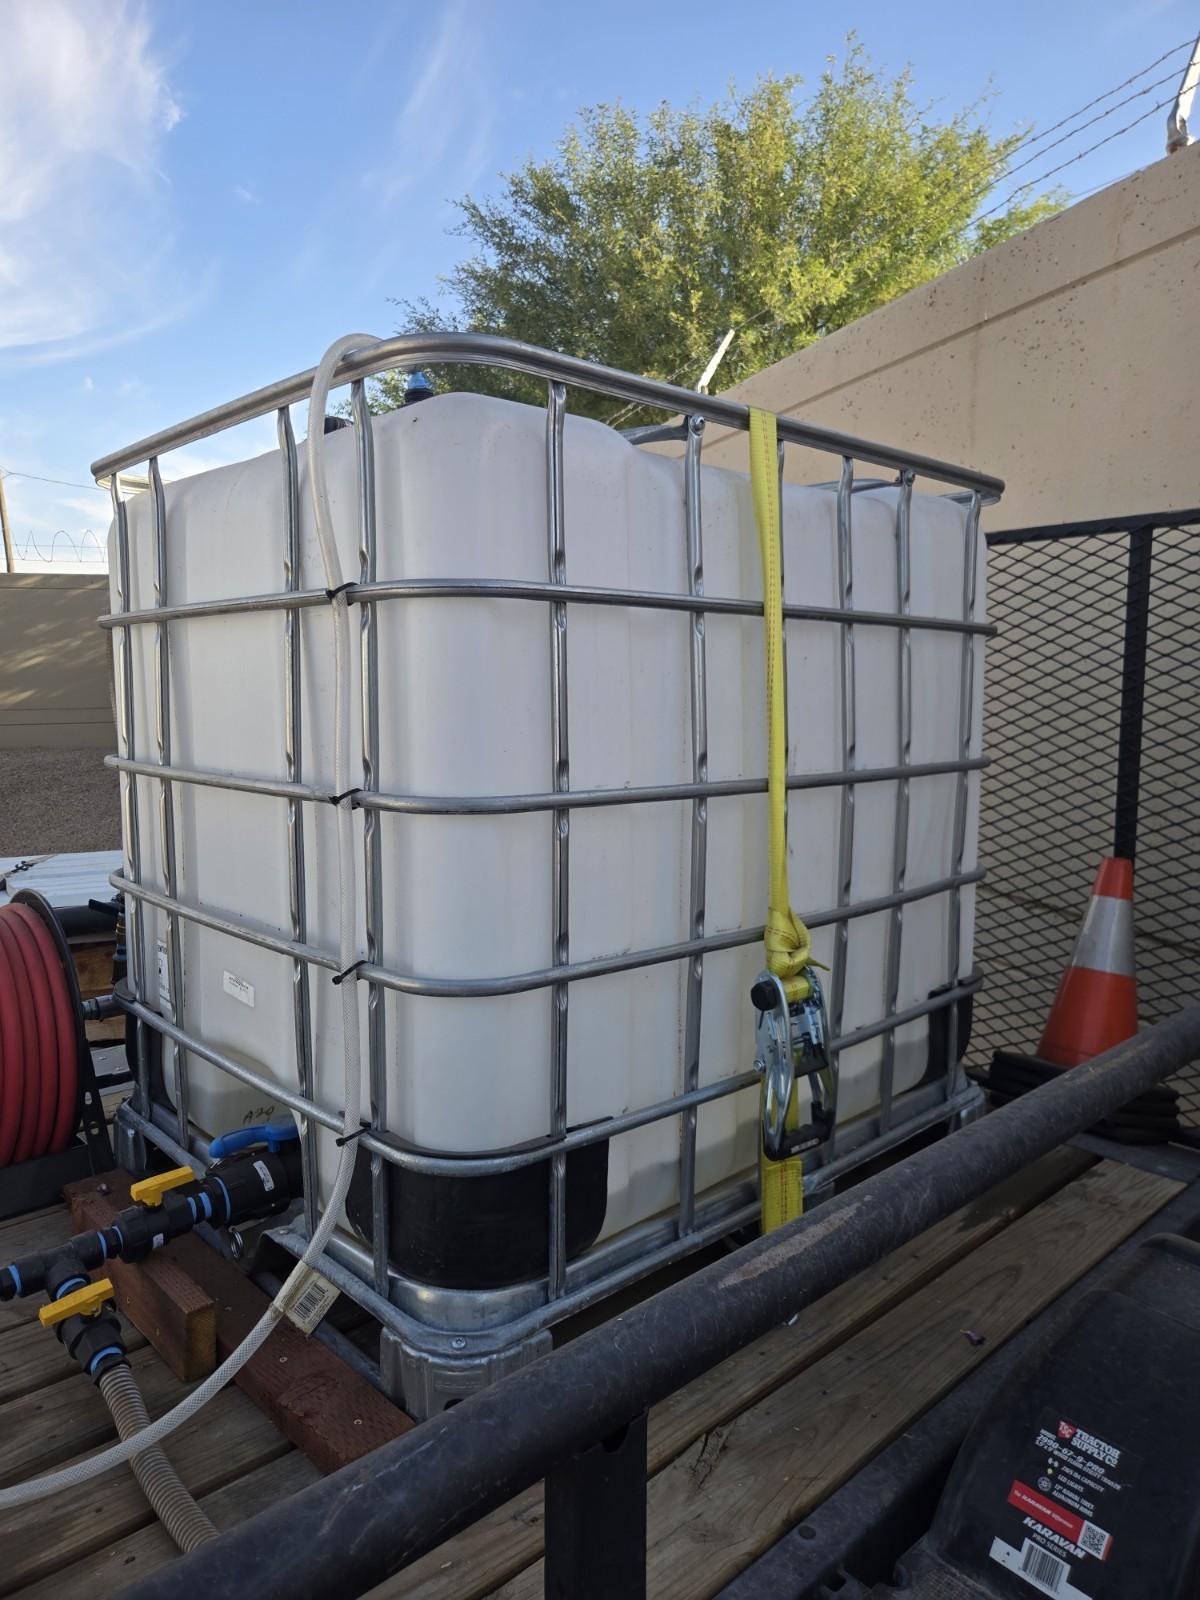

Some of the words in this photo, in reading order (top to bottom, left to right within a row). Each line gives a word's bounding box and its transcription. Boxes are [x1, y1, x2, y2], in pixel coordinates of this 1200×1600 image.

[1059, 1421, 1072, 1438] TSC
[1071, 1437, 1106, 1461] SUPPLY
[1075, 1428, 1121, 1459] TRACTOR
[1066, 1479, 1085, 1493] LIGHTS
[1080, 1476, 1104, 1492] CAPACITY
[1082, 1465, 1101, 1479] UTILITY
[1101, 1476, 1121, 1491] TRAILER
[1022, 1494, 1051, 1515] KARAVAN
[1080, 1498, 1095, 1510] TIRES
[1022, 1516, 1087, 1559] KARAVAN
[1032, 1532, 1046, 1544] PRO
[1046, 1540, 1067, 1558] SERIES
